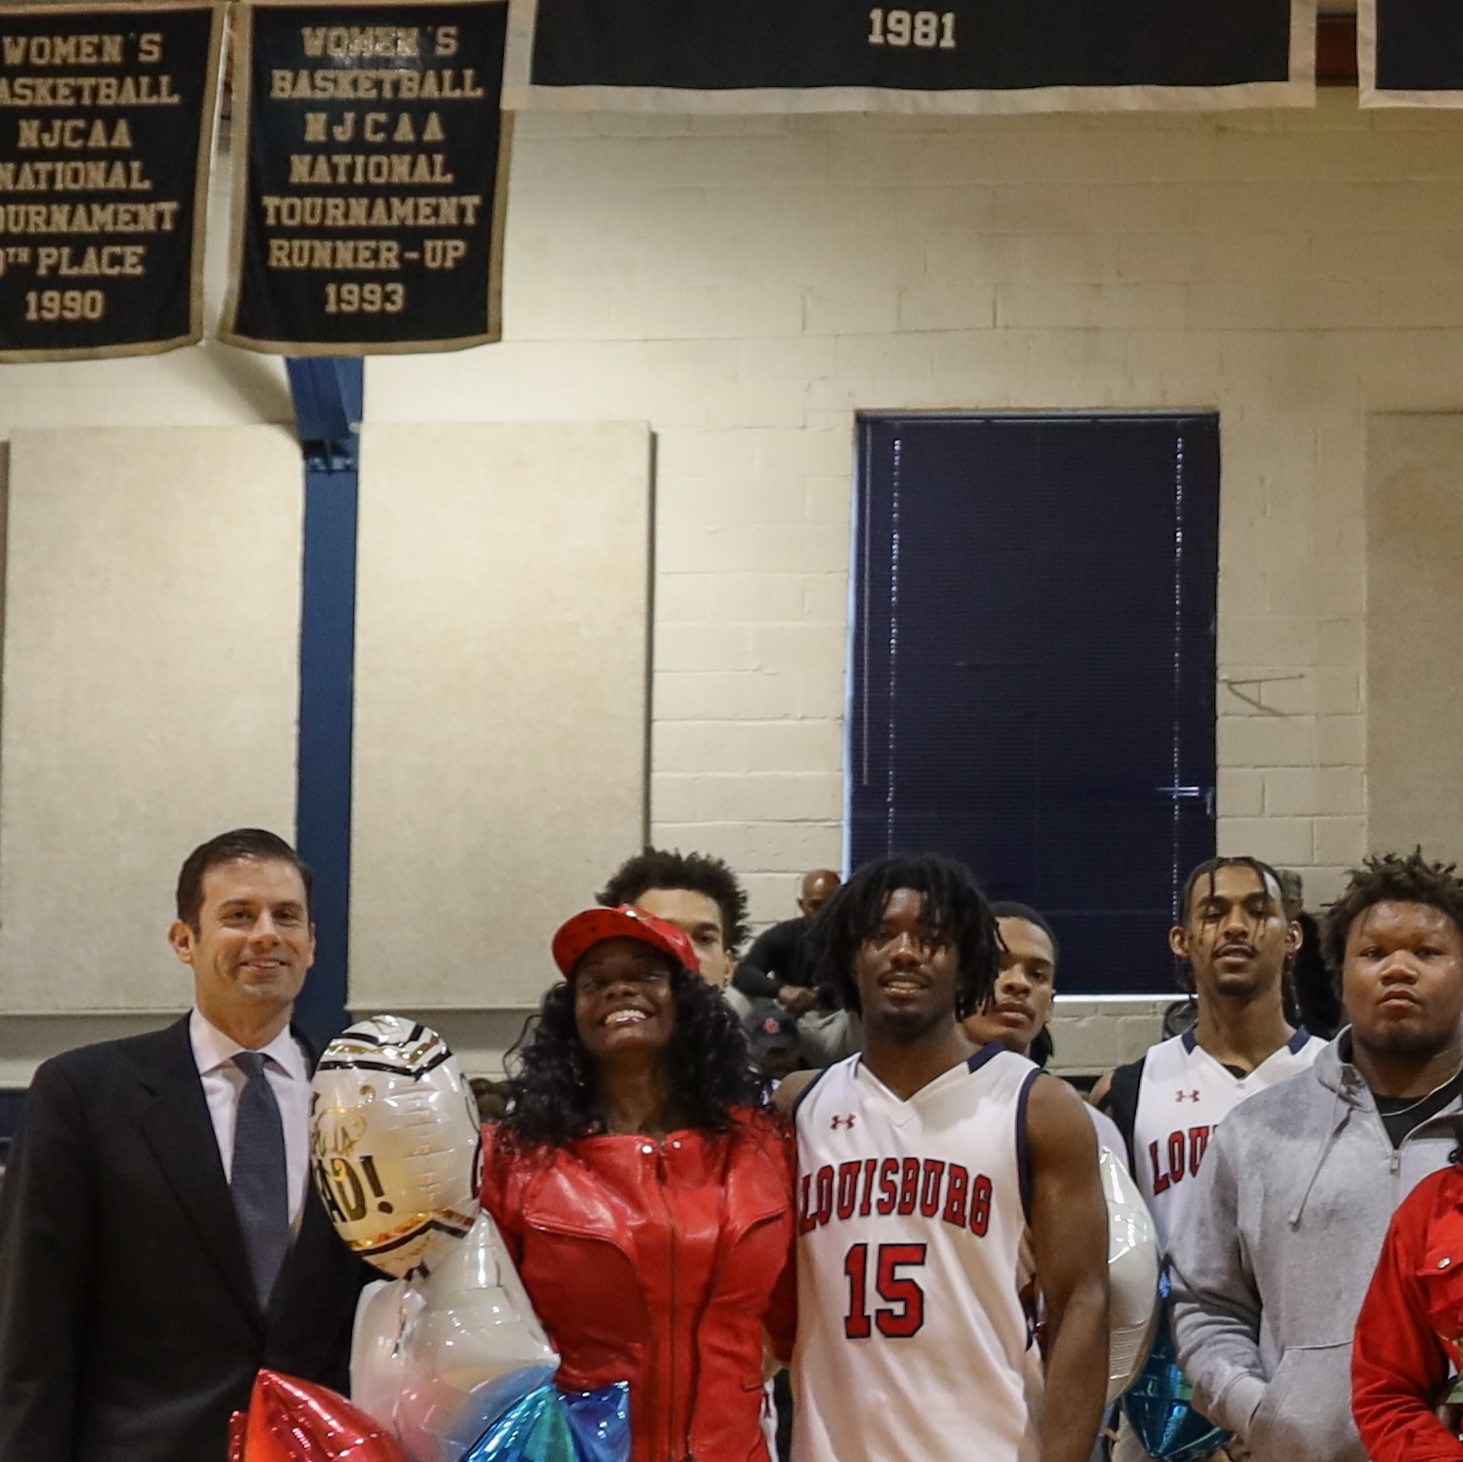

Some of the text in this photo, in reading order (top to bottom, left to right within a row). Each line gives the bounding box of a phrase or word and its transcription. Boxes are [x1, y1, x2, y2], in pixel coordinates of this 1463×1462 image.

[868, 8, 956, 47] 1981
[0, 75, 181, 106] ASKETBALL
[270, 69, 484, 99] BASKETBALL
[18, 119, 132, 147] NJCAA
[305, 112, 446, 143] NJCAA
[289, 155, 454, 184] NATIONAL
[262, 196, 482, 226] TOURNAMENT
[37, 246, 145, 275] PLACE
[268, 240, 468, 270] RUNNER-UP
[26, 290, 104, 320] 1990
[325, 283, 406, 313] 1993
[800, 1157, 993, 1238] LOUISBURG
[844, 1243, 927, 1339] 15
